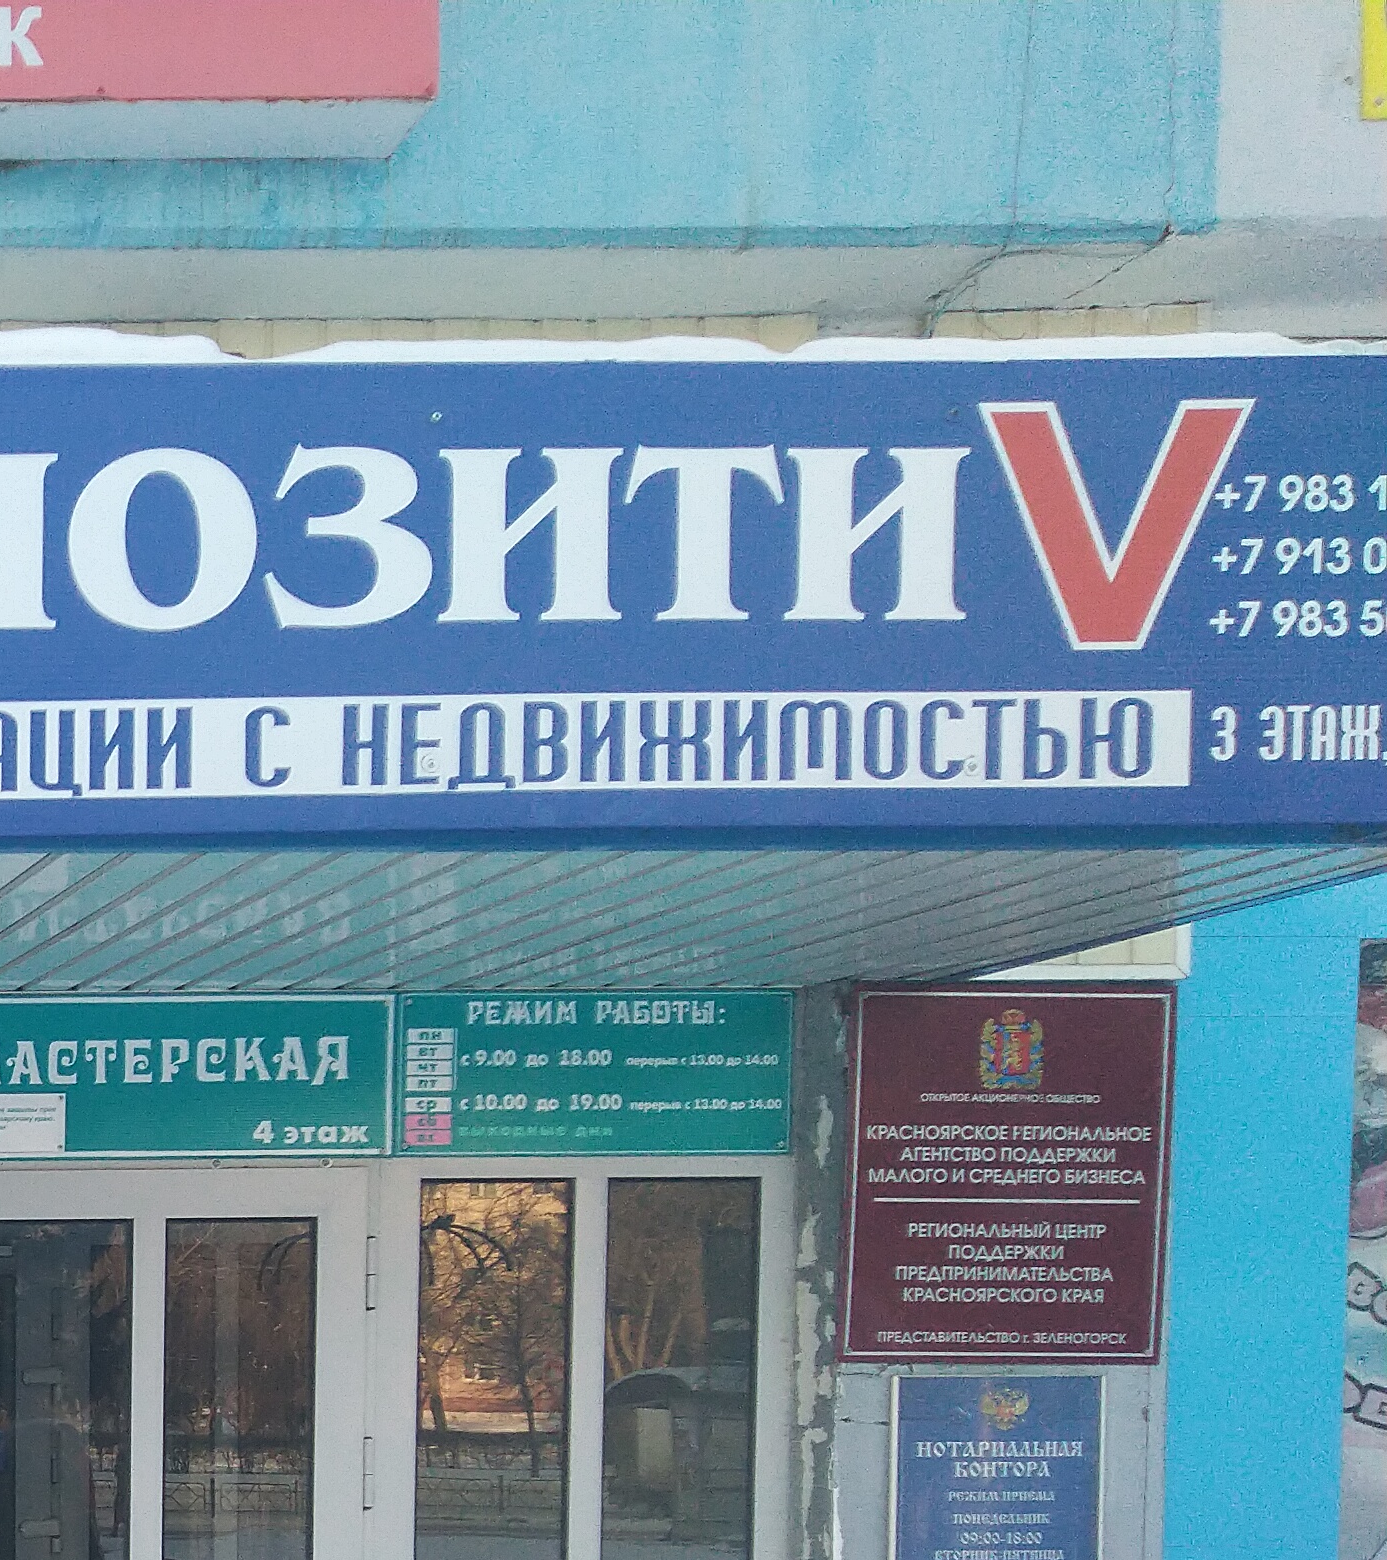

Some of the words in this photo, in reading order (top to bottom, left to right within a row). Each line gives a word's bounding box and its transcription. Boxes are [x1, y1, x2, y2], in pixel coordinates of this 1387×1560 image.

[1215, 475, 1267, 512] +7
[1279, 475, 1355, 512] 983
[1211, 538, 1263, 574] +7
[1276, 537, 1351, 574] 913
[1209, 601, 1261, 637] +7
[1273, 600, 1349, 637] 983
[1210, 705, 1237, 762] 3
[244, 703, 292, 788] С
[341, 697, 1153, 792] НЕДВИЖИМОСТЬЮ
[467, 1000, 577, 1025] РЕЖИМ
[596, 1000, 726, 1025] РАБОТЫ:
[475, 1050, 516, 1066] 9.00
[525, 1054, 549, 1067] до
[559, 1050, 612, 1066] 18.00
[474, 1094, 527, 1110] 10.00
[536, 1098, 560, 1112] до
[252, 1120, 275, 1144] 4
[283, 1122, 369, 1148] этаж
[867, 1125, 1008, 1141] КРАСНОЯРСКОЕ
[1012, 1126, 1152, 1142] РЕГИОНАЛЬНОЕ
[899, 1147, 996, 1162] АГЕНТСТВО
[1000, 1148, 1116, 1164] ПОДДЕРЖКИ
[868, 1169, 947, 1184] МАЛОГО
[952, 1169, 964, 1184] И
[970, 1169, 1060, 1186] СРЕДНЕГО
[1064, 1169, 1146, 1185] БИЗНЕСА
[907, 1221, 1051, 1239] РЕГИОНАЛЬНЫЙ
[1055, 1223, 1107, 1240] ЦЕНТР
[948, 1245, 1064, 1261] ПОДДЕРЖКИ
[895, 1266, 1114, 1283] ПРЕДПРИНИМАТЕЛЬСТВА
[903, 1288, 1057, 1303] КРАСНОЯРСКОГО
[1061, 1288, 1105, 1303] КРАЯ
[878, 1331, 1020, 1344] ПРЕДСТАВИТЕЛЬСТВО
[1033, 1332, 1127, 1345] ЗЕЛЕНОГОРСК
[915, 1441, 1084, 1458] НОТАРИАЛЬНАЯ
[954, 1461, 1052, 1478] КОНТОРА
